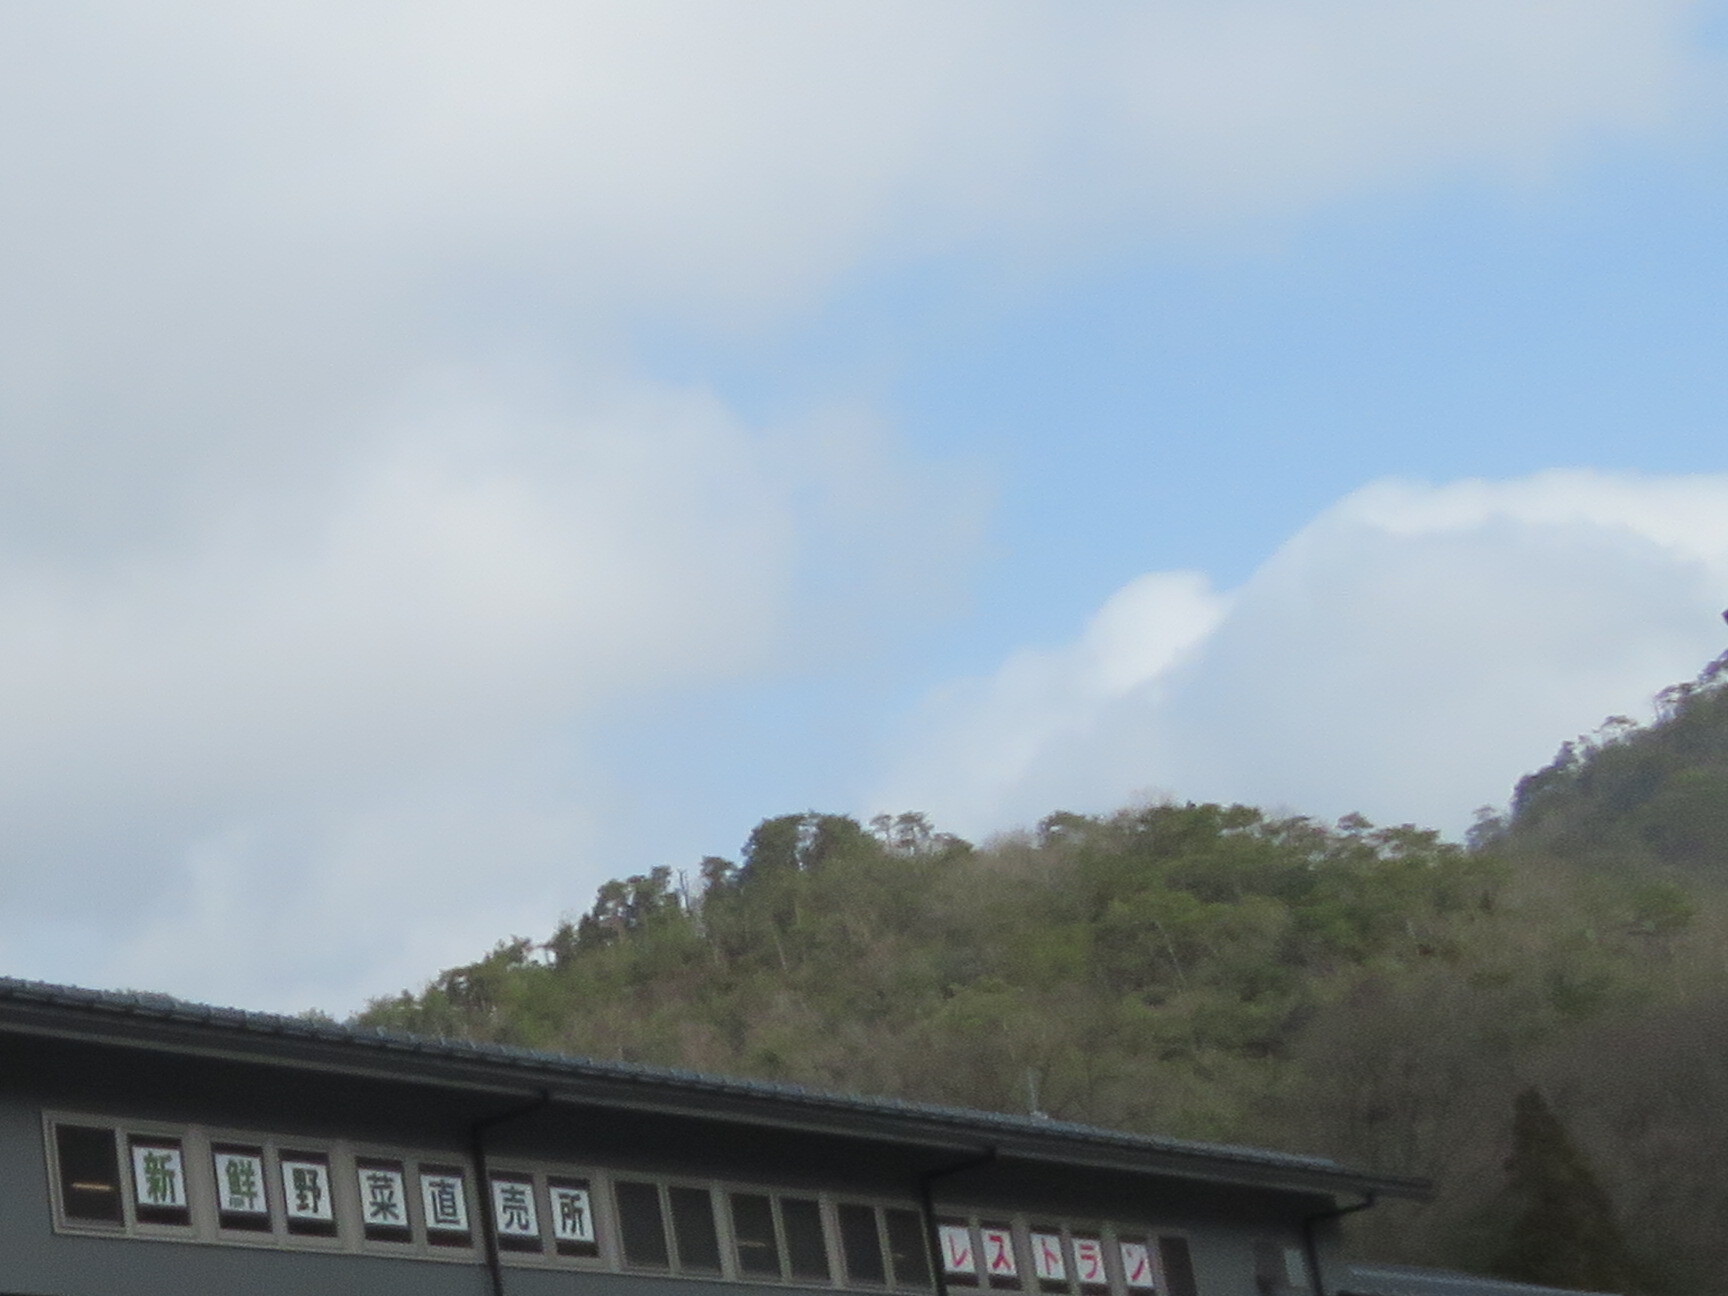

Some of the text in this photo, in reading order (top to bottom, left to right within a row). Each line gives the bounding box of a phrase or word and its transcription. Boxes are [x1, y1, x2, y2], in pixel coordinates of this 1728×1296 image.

[948, 1232, 1144, 1281] レストラン
